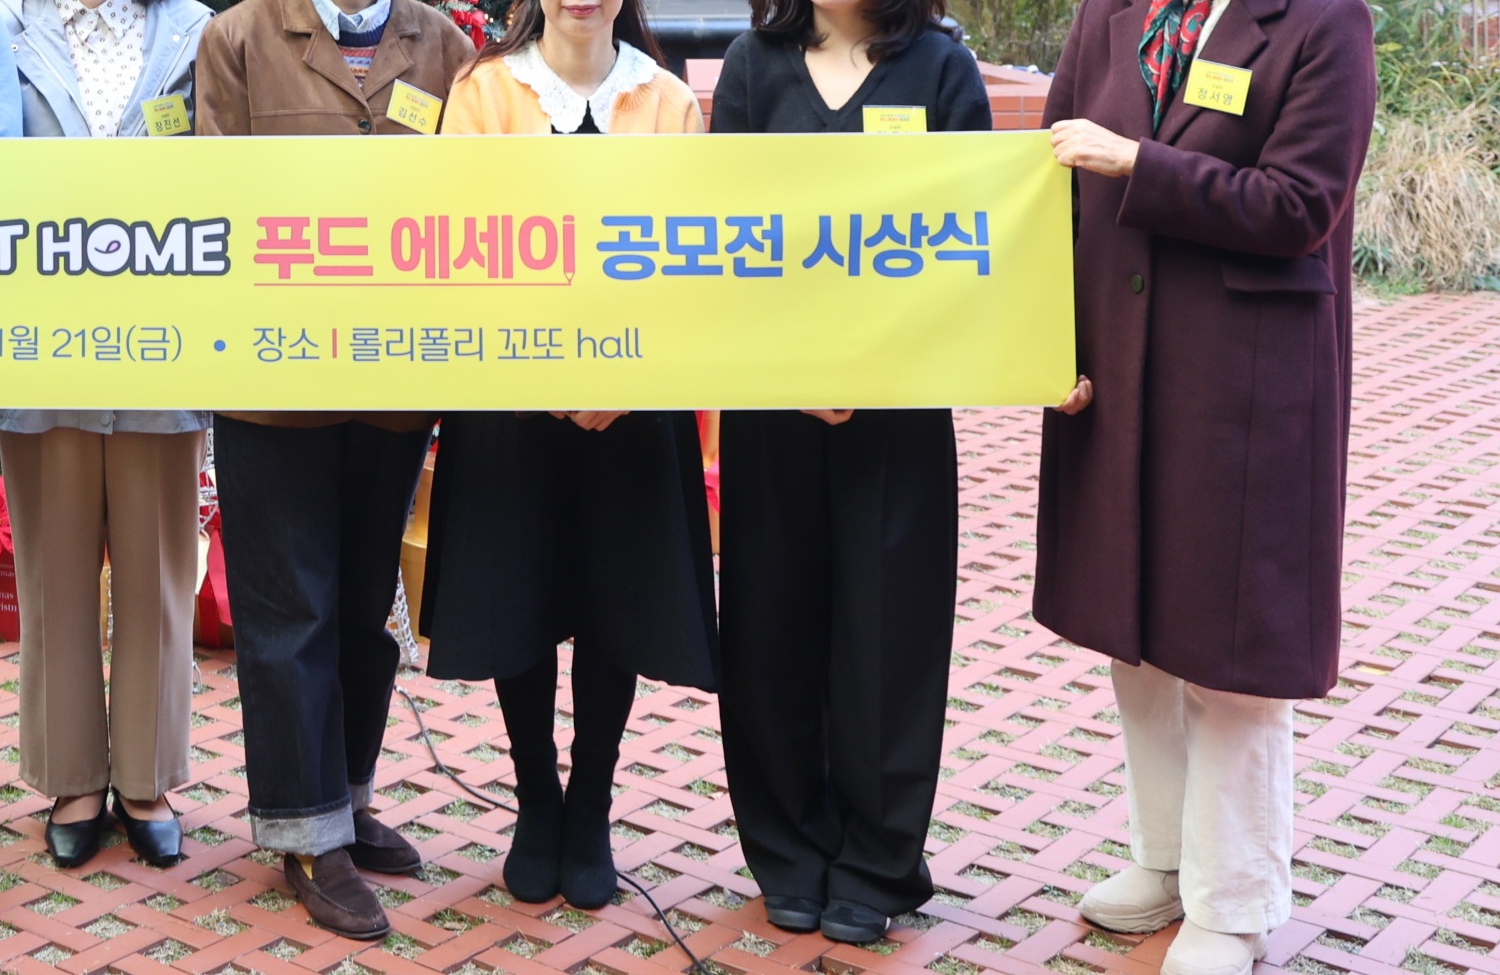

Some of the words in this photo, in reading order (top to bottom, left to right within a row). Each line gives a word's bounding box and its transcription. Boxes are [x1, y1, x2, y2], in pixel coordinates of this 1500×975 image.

[1197, 87, 1233, 105] 정서영
[155, 117, 181, 132] 장진선
[37, 217, 231, 277] HOME
[253, 216, 373, 280] 푸드
[390, 214, 576, 284] 에세이
[596, 213, 785, 281] 공모전
[802, 210, 991, 279] 시상식
[51, 325, 183, 362] 21일(금)
[253, 326, 320, 363] 장소
[349, 327, 484, 362] 롤리폴리
[497, 328, 565, 360] 꼬또
[576, 328, 642, 359] hall
